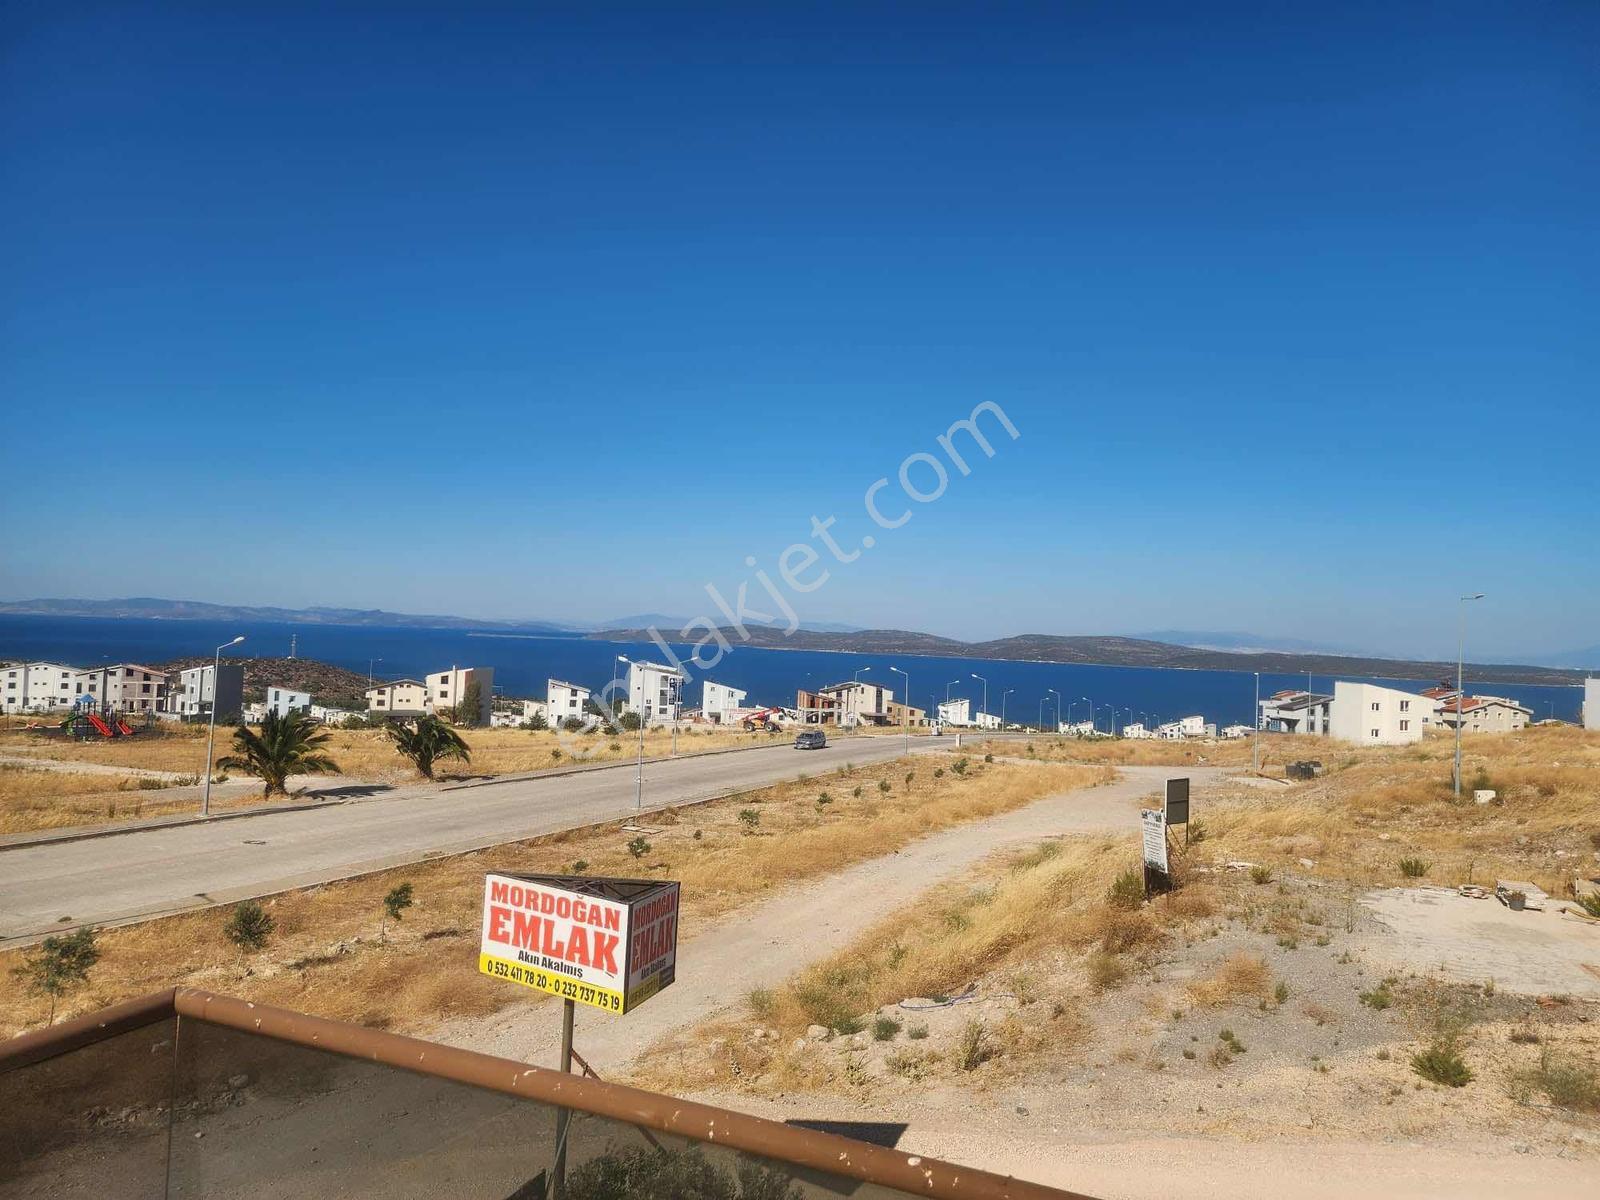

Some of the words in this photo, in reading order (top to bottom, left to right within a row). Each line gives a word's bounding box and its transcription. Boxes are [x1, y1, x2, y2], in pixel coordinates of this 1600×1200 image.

[491, 881, 622, 932] MORDOĞAN
[488, 906, 620, 975] EMLAK
[518, 950, 540, 965] Akın
[541, 957, 583, 979] Akalmış
[487, 960, 493, 972] 0
[495, 961, 509, 977] 532
[510, 966, 522, 982] 411
[524, 969, 535, 984] 78
[537, 973, 547, 988] 20
[554, 979, 560, 992] 0
[562, 981, 577, 998] 232
[579, 986, 595, 1003] 737
[598, 991, 608, 1007] 75
[610, 994, 620, 1010] 19
